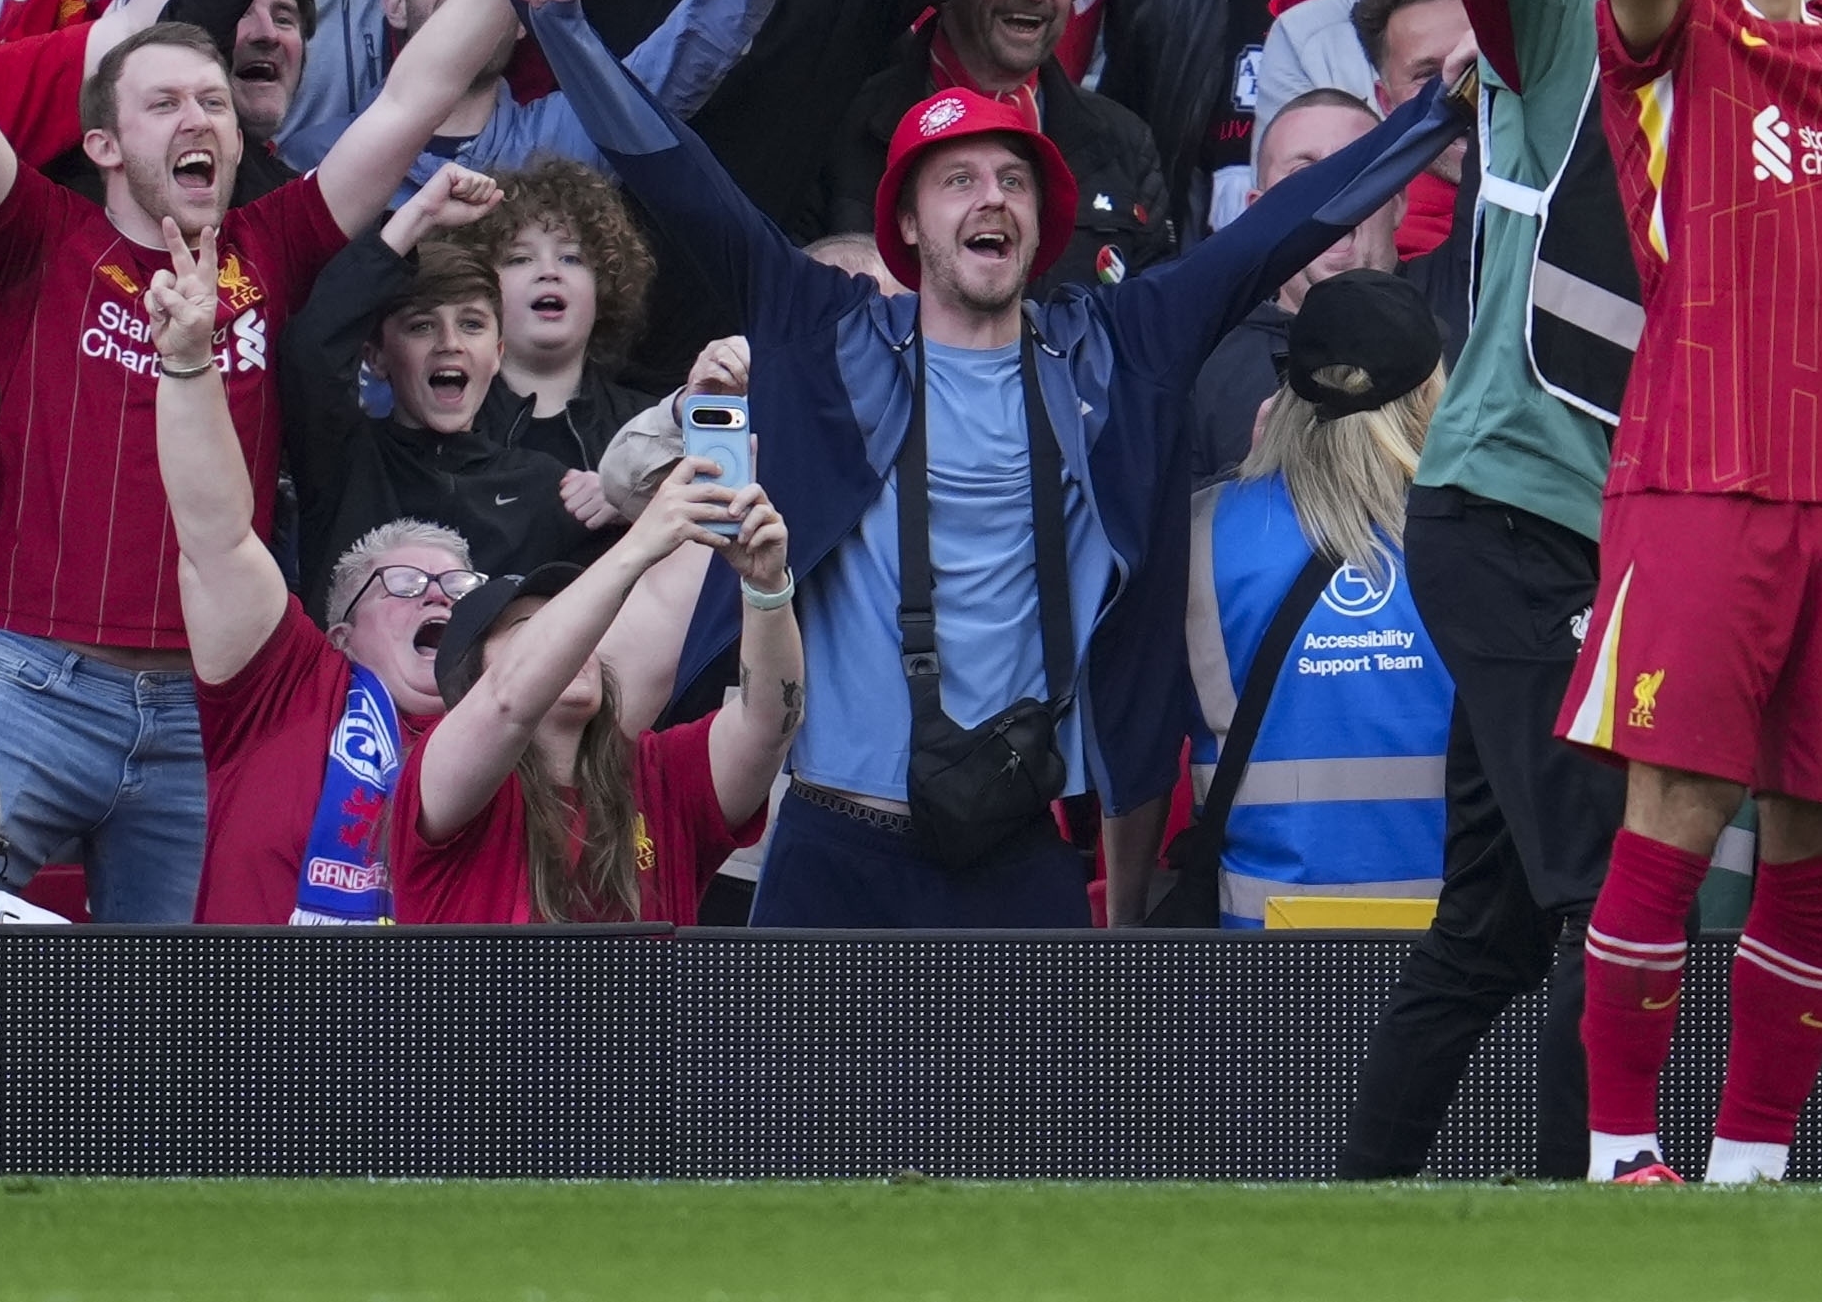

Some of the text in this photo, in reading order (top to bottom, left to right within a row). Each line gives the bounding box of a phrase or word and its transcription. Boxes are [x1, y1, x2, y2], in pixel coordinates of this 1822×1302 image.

[1303, 632, 1415, 661] Accessibility
[1298, 652, 1424, 682] Support Team
[1628, 711, 1655, 729] LFC
